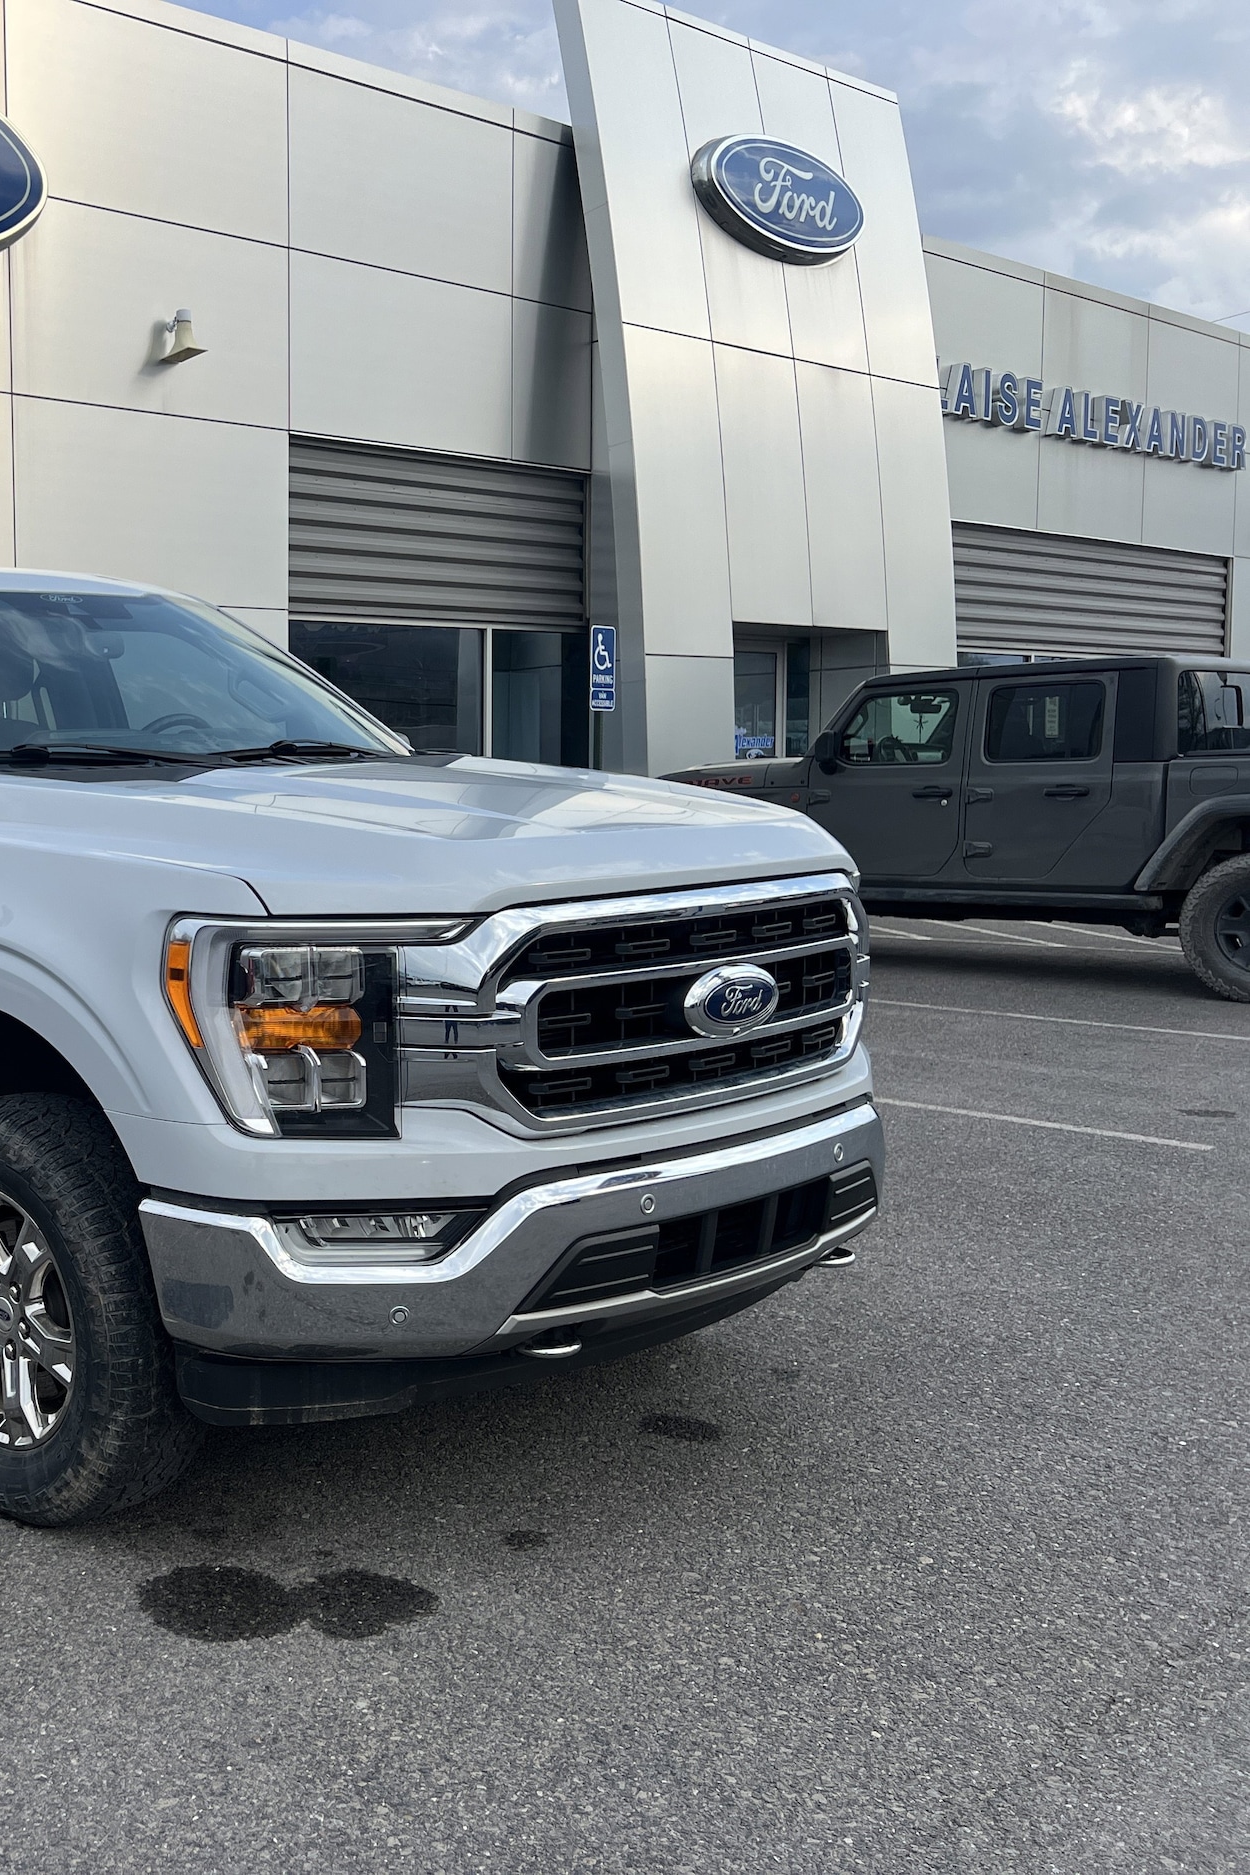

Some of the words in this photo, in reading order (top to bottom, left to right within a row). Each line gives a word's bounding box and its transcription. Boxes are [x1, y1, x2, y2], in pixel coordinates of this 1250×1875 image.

[754, 157, 838, 231] Ford
[1053, 385, 1247, 471] ALEXANDER
[592, 674, 613, 684] PARKING
[721, 984, 764, 1018] Ford
